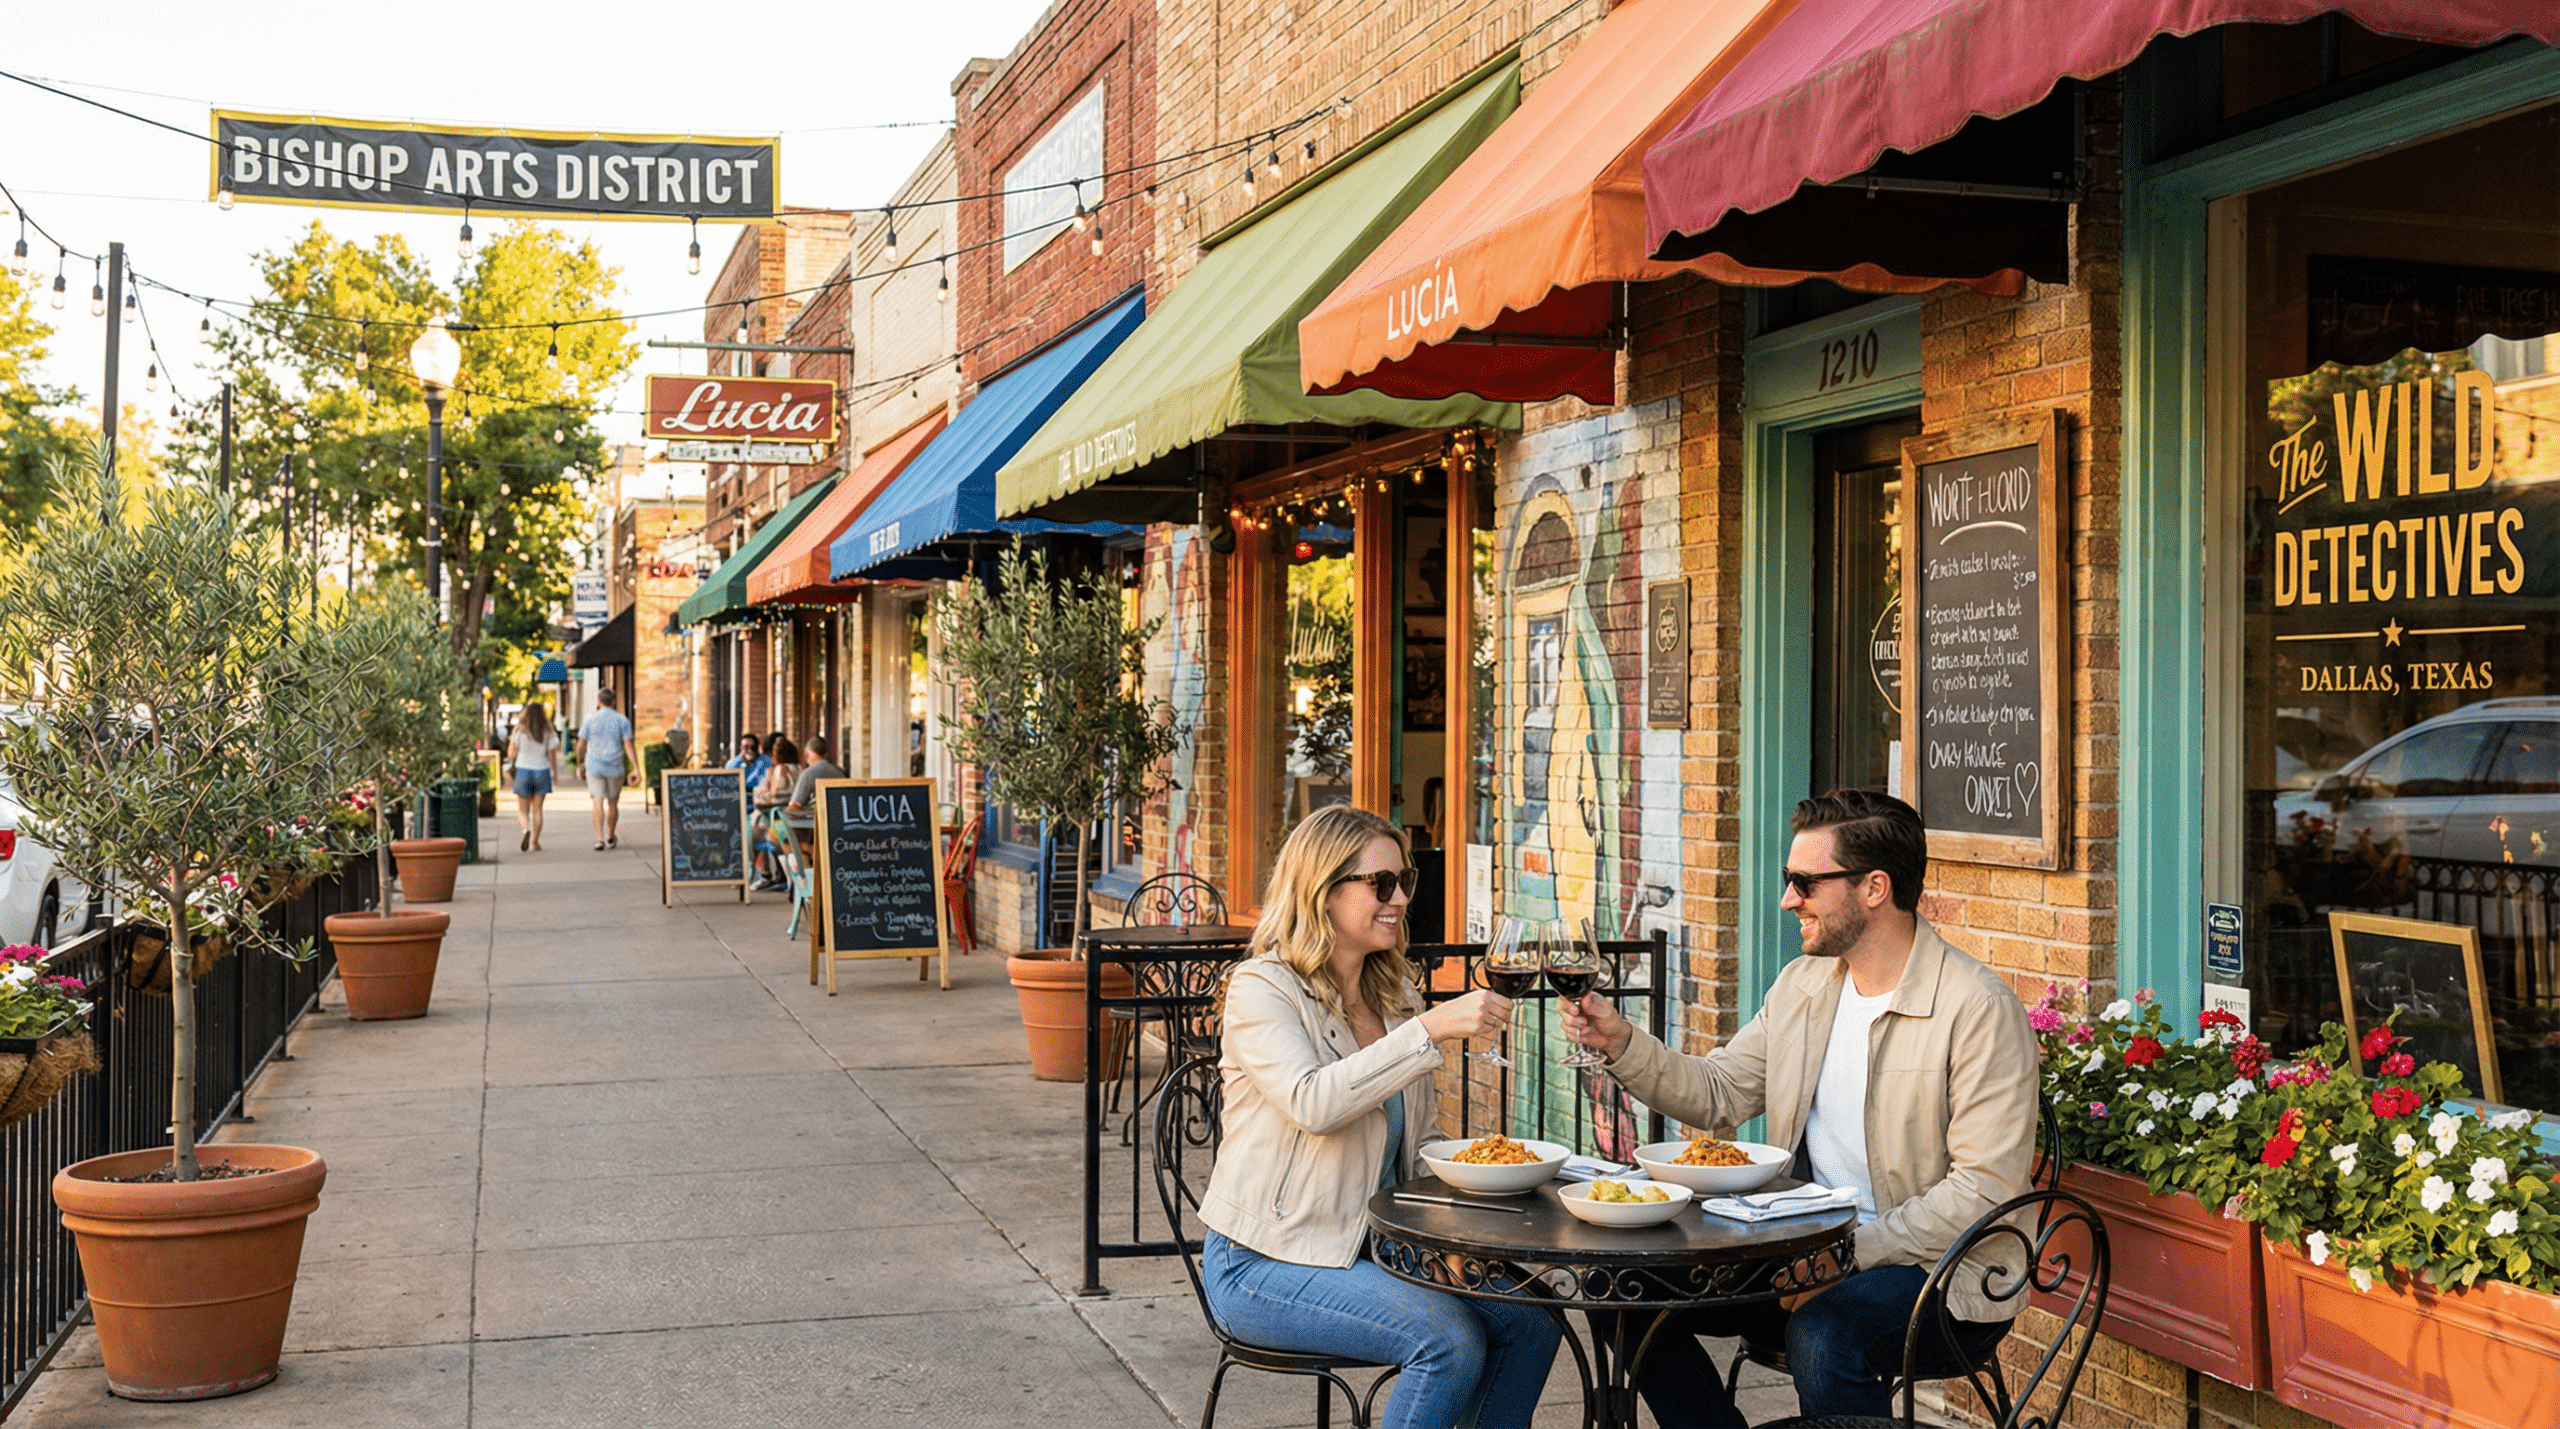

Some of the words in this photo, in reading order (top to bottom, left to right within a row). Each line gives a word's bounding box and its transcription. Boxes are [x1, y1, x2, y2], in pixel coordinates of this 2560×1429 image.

[232, 135, 409, 192] BISHOP
[424, 147, 539, 199] ARTS
[556, 152, 759, 205] DISTRICT
[1387, 257, 1459, 341] LUCÍA
[1818, 327, 1879, 392] 1210
[661, 381, 825, 433] Lucia
[2268, 414, 2328, 504] The
[2333, 369, 2495, 503] WILD
[2275, 507, 2525, 607] DETECTIVES
[2300, 664, 2400, 696] DALLAS,
[2407, 661, 2493, 690] TEXAS
[841, 794, 914, 823] LUCIA
